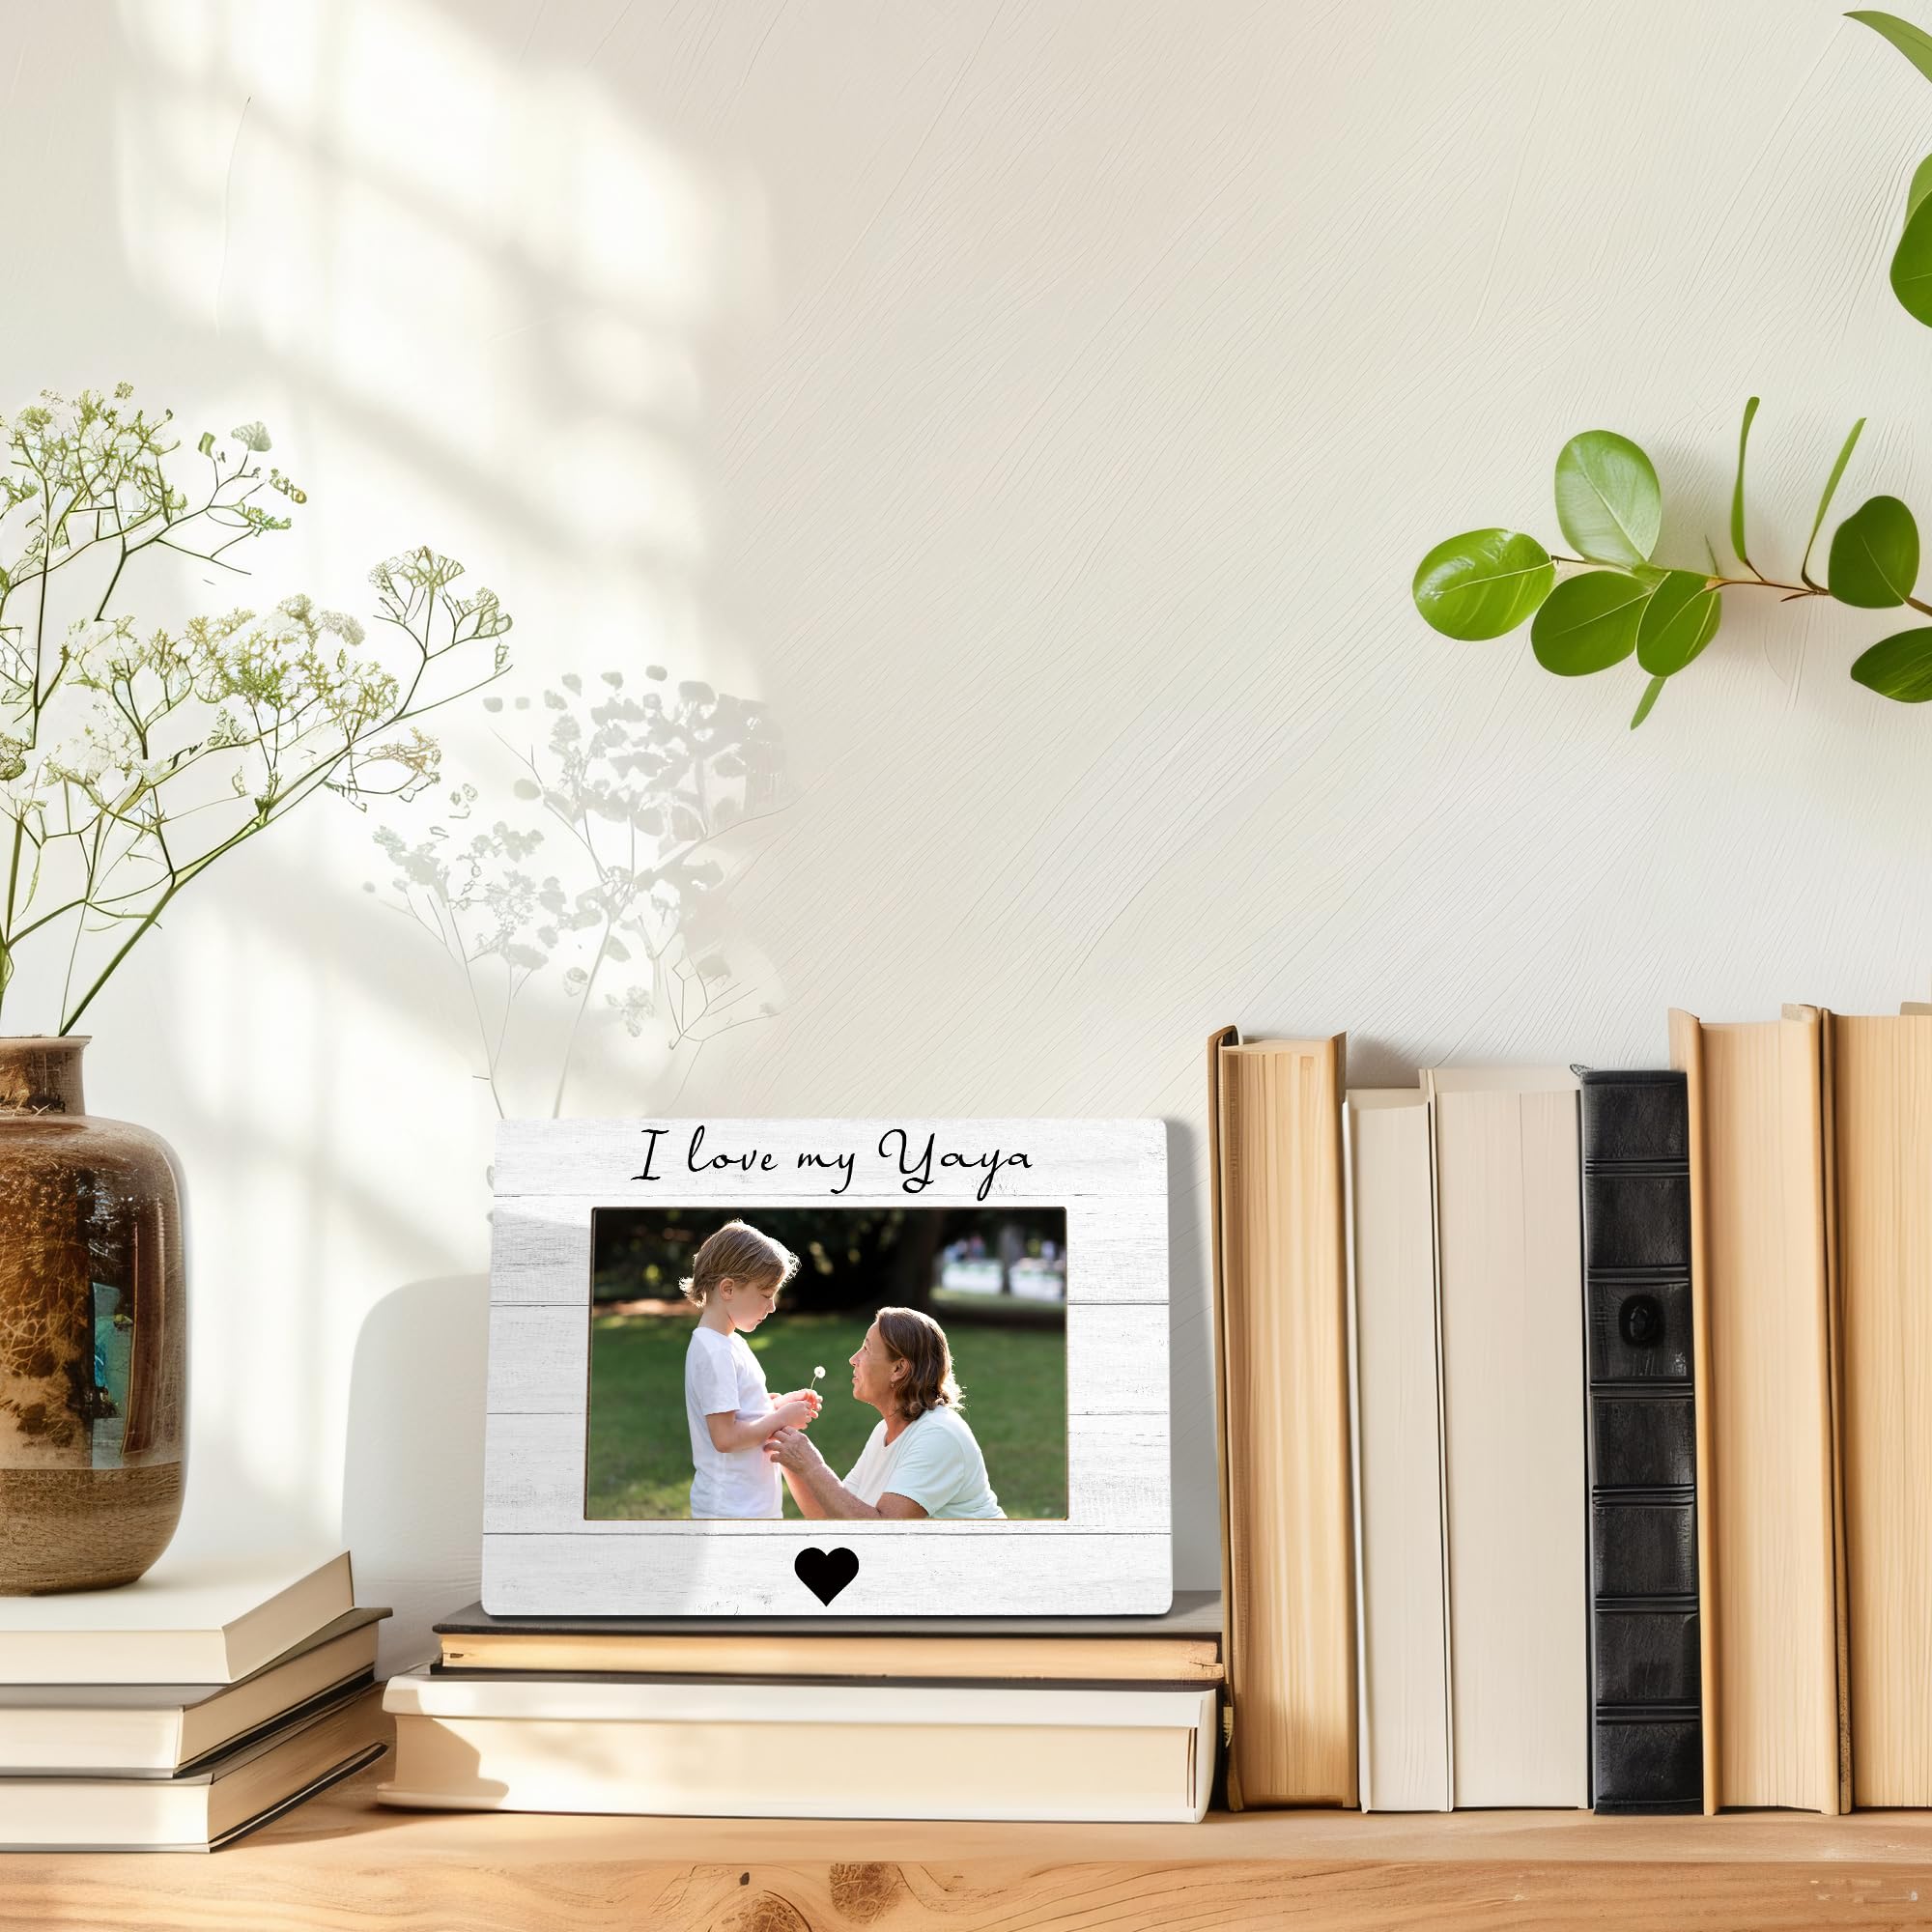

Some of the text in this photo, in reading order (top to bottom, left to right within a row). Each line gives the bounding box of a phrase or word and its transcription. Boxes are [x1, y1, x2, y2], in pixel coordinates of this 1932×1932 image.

[630, 1124, 1034, 1202] I love my Yaya
